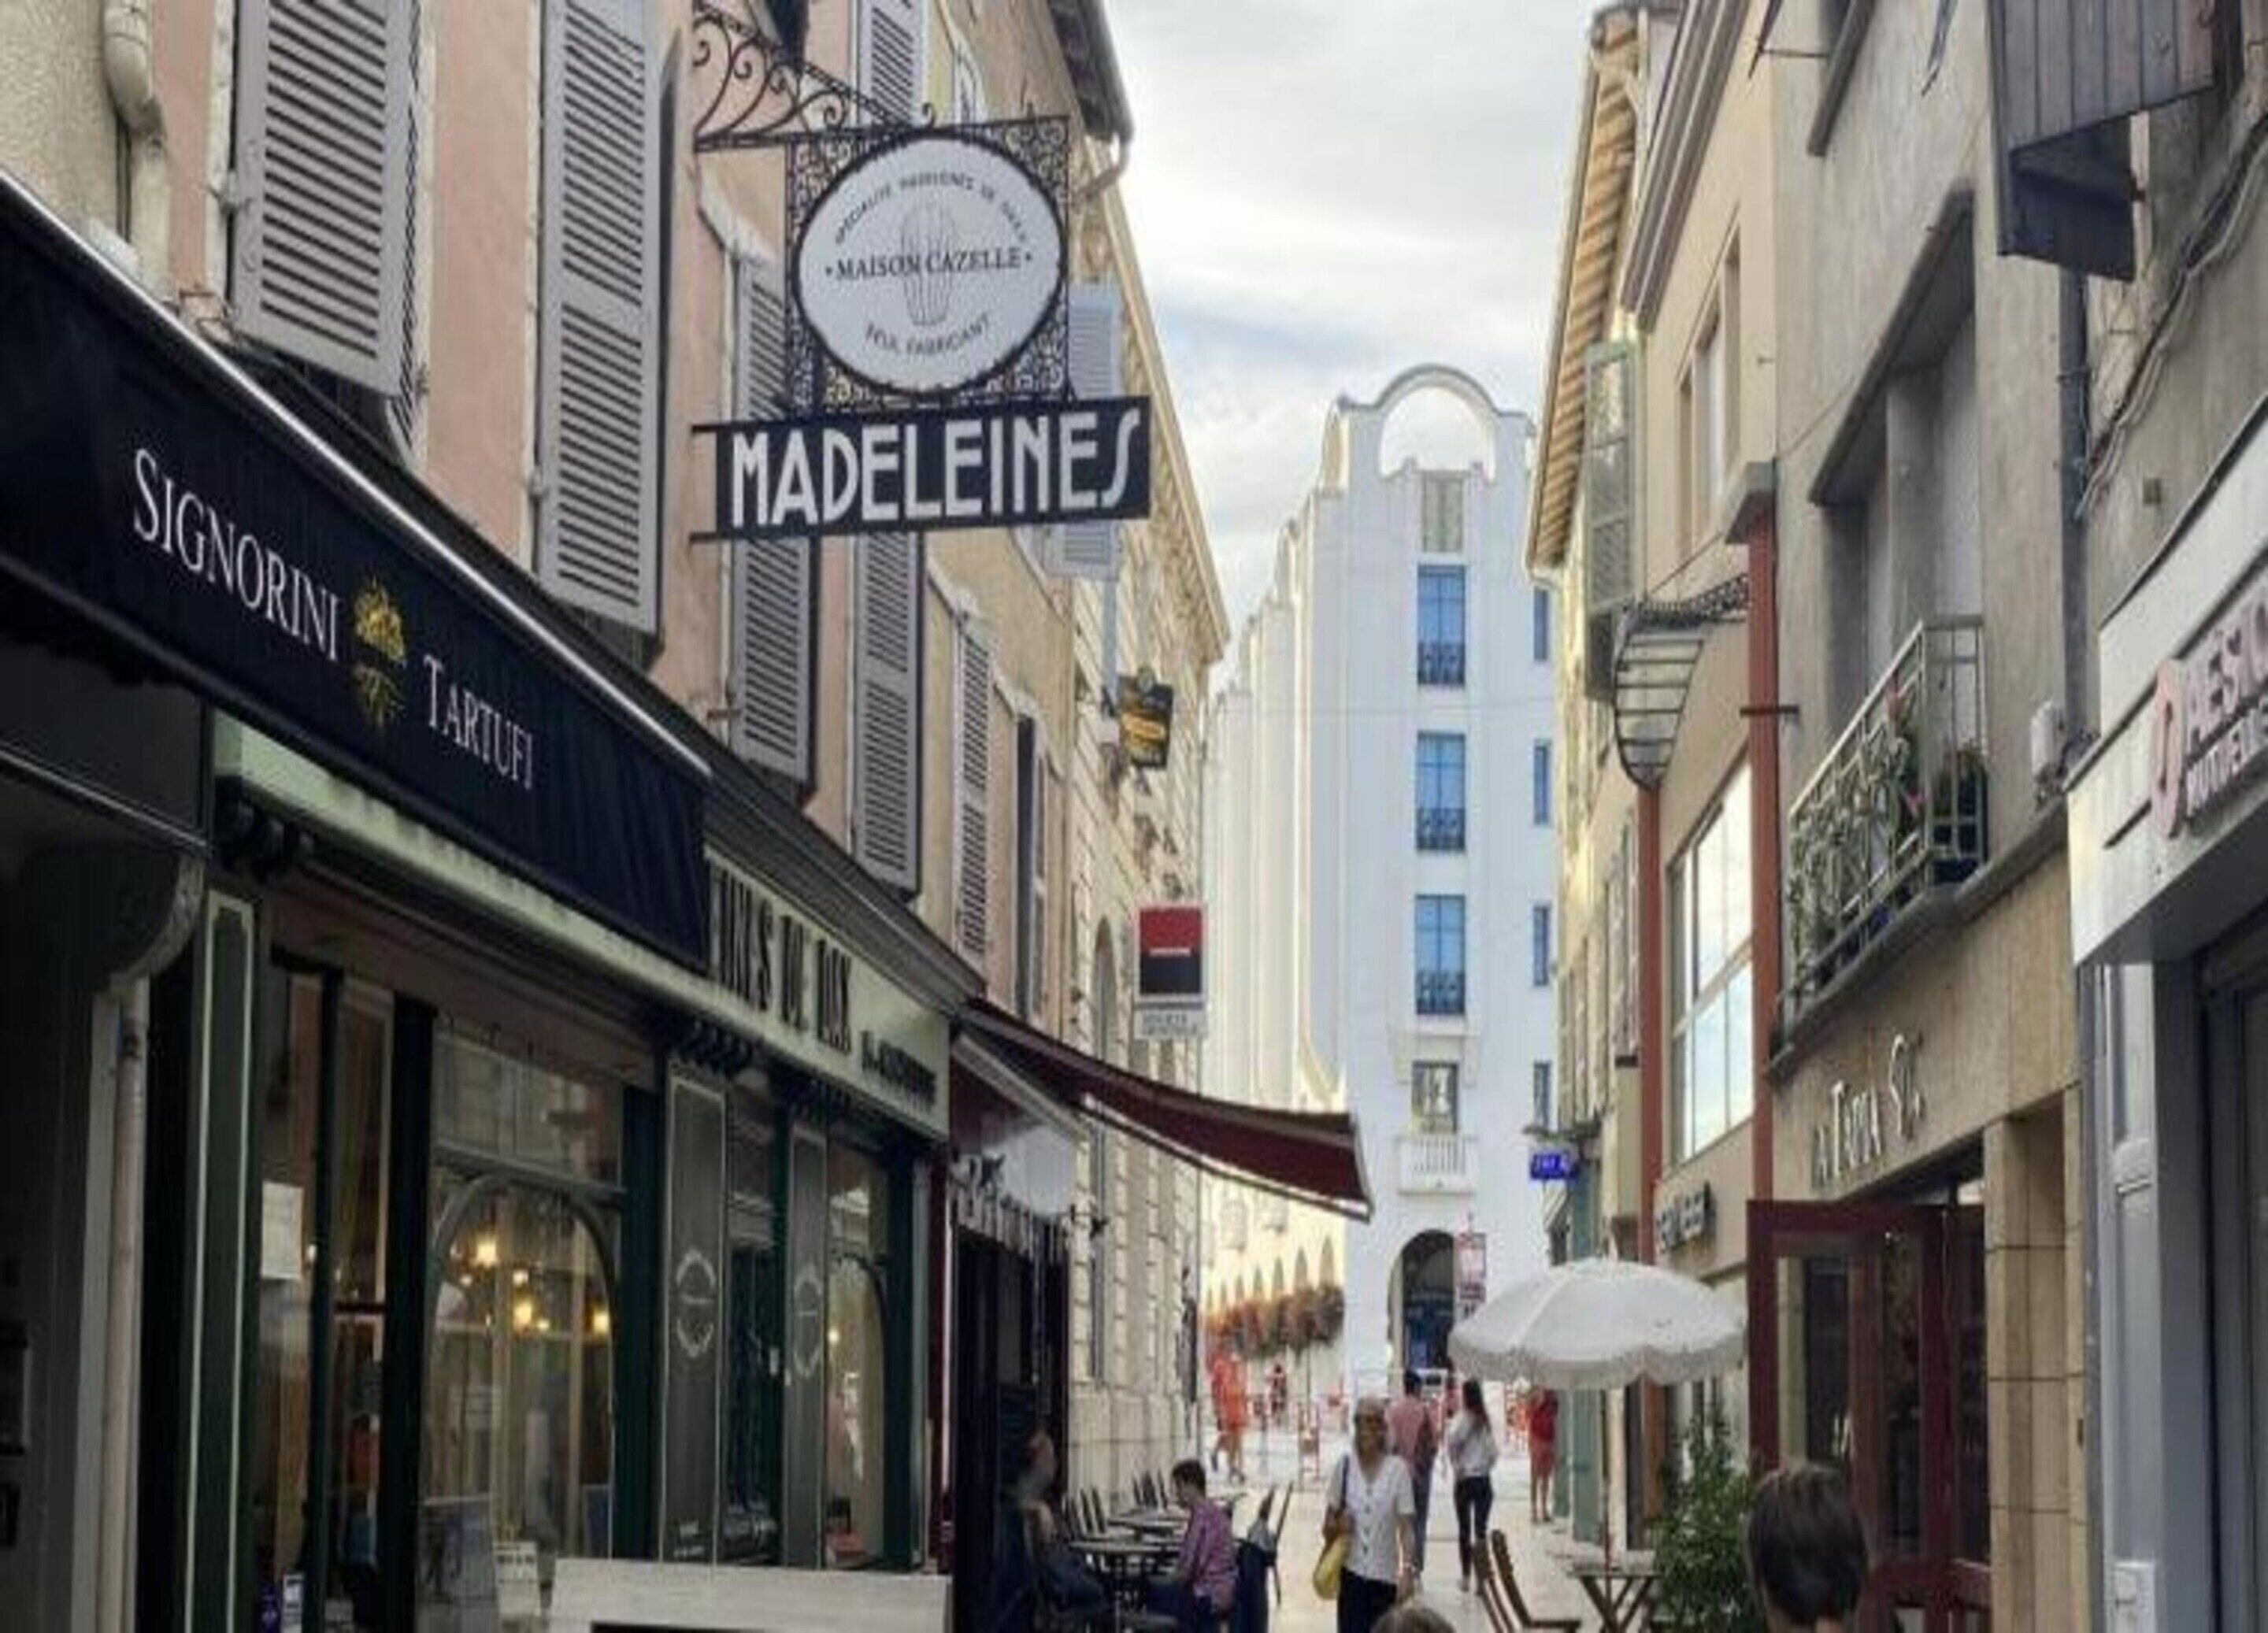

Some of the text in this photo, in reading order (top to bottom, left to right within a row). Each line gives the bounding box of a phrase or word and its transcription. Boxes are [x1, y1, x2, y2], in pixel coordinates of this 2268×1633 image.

[835, 246, 1022, 280] MAISON CAZELLE
[732, 406, 1140, 528] MADELEINES
[132, 447, 534, 789] SIGNORINI TARTUFI
